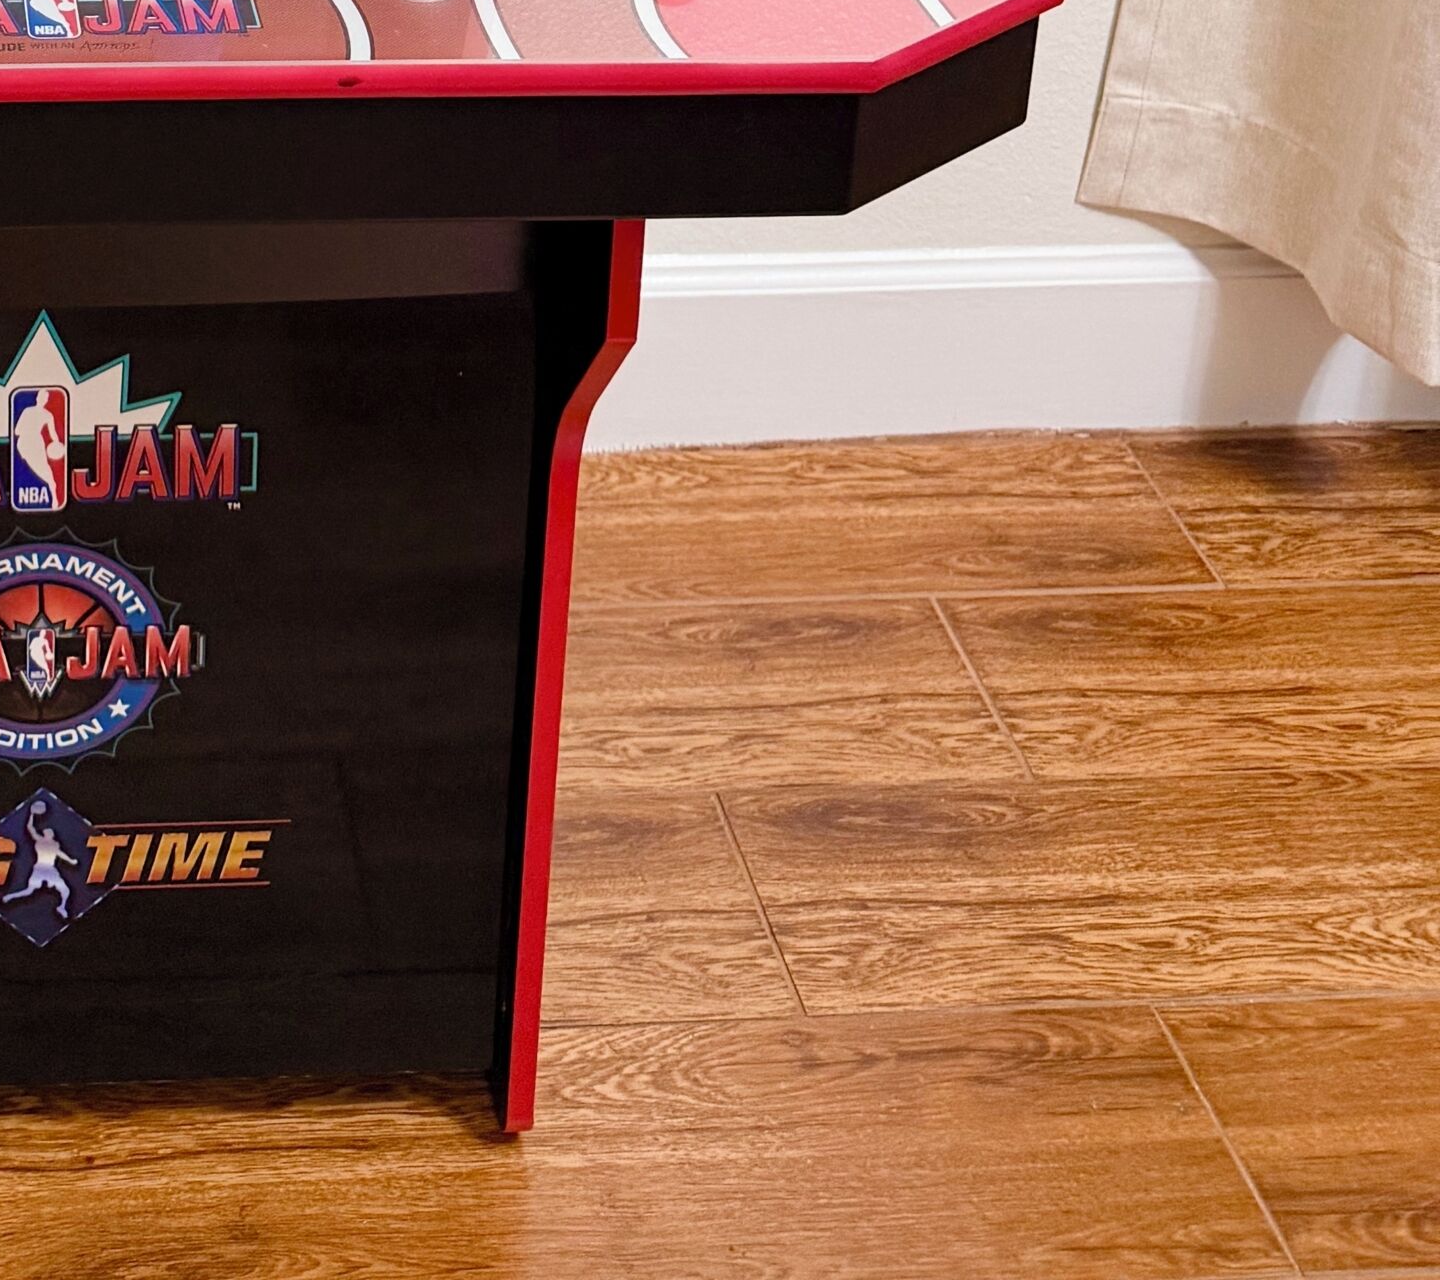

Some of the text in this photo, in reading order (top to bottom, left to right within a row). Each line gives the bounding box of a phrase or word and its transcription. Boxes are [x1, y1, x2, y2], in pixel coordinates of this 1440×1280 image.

[34, 25, 65, 36] NBA
[72, 423, 242, 505] JAM
[17, 487, 49, 506] NBA
[65, 624, 192, 680] JAM
[85, 830, 272, 884] TIME
